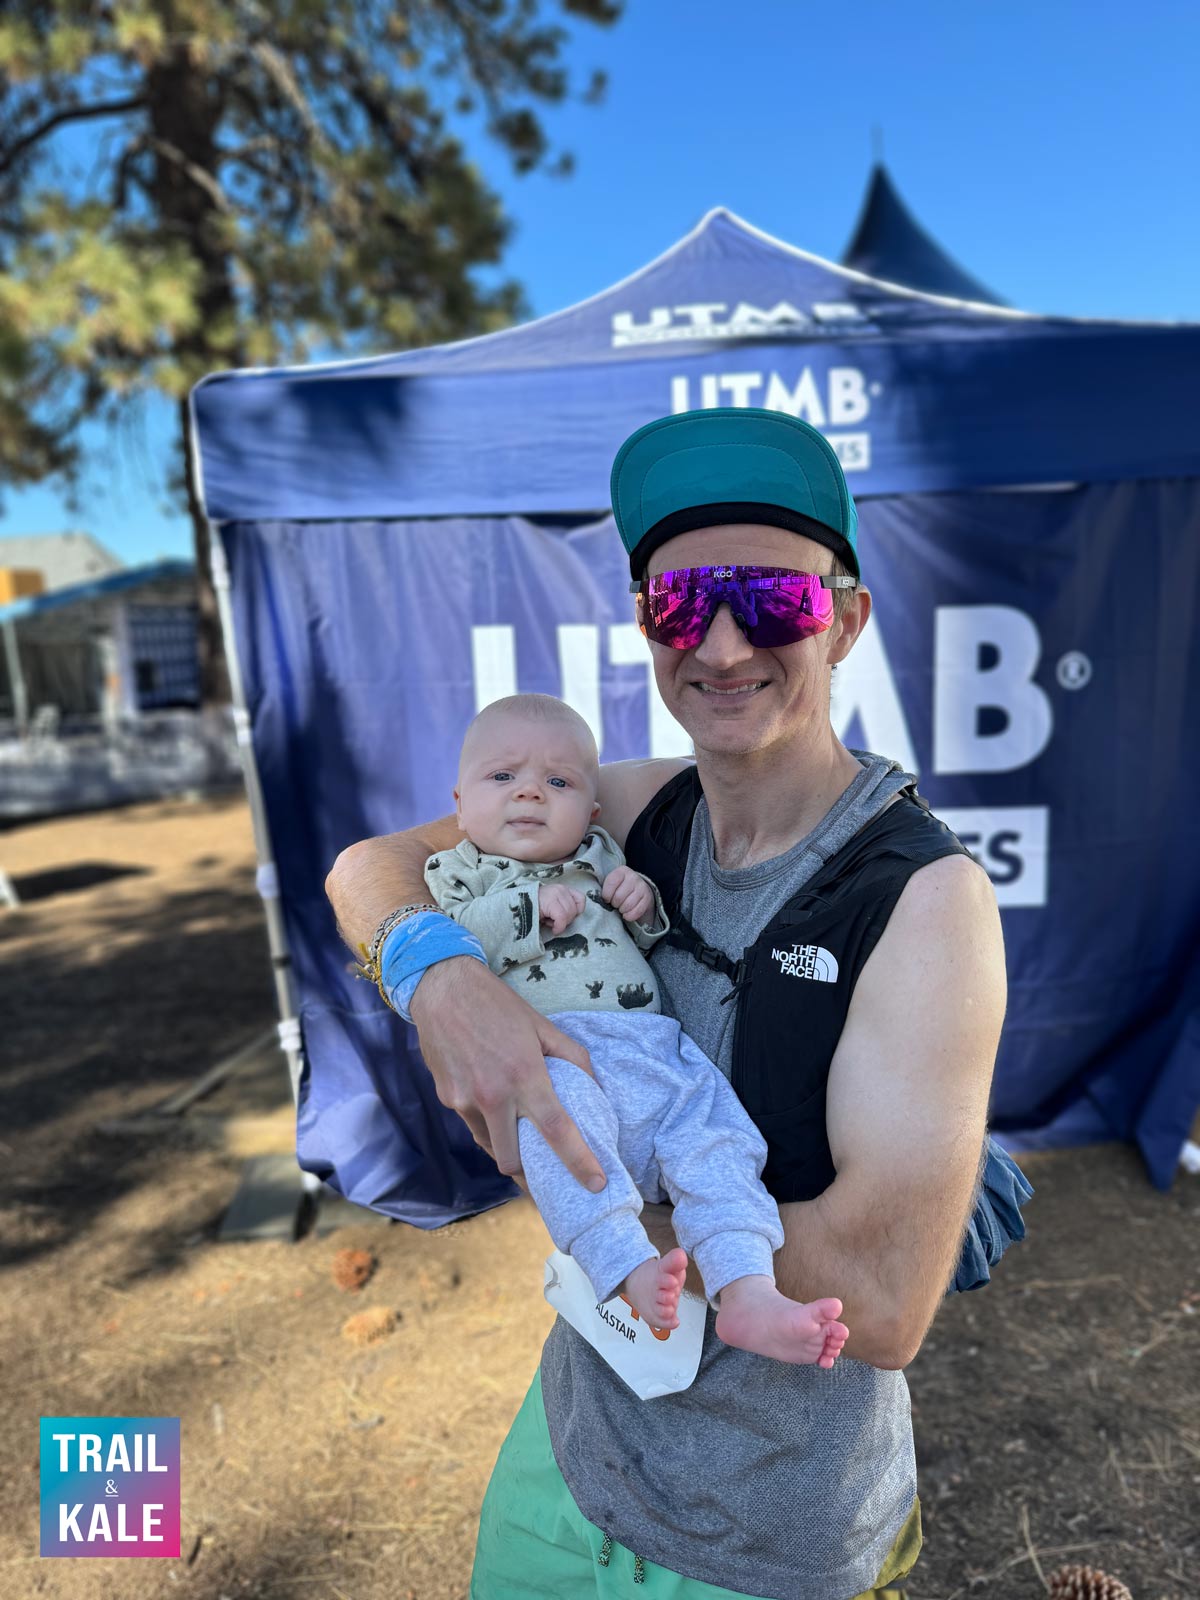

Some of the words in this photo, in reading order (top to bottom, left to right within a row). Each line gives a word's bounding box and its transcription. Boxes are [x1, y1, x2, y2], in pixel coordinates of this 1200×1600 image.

[771, 948, 816, 968] NORTH
[791, 944, 817, 956] THE
[780, 962, 813, 979] FACE
